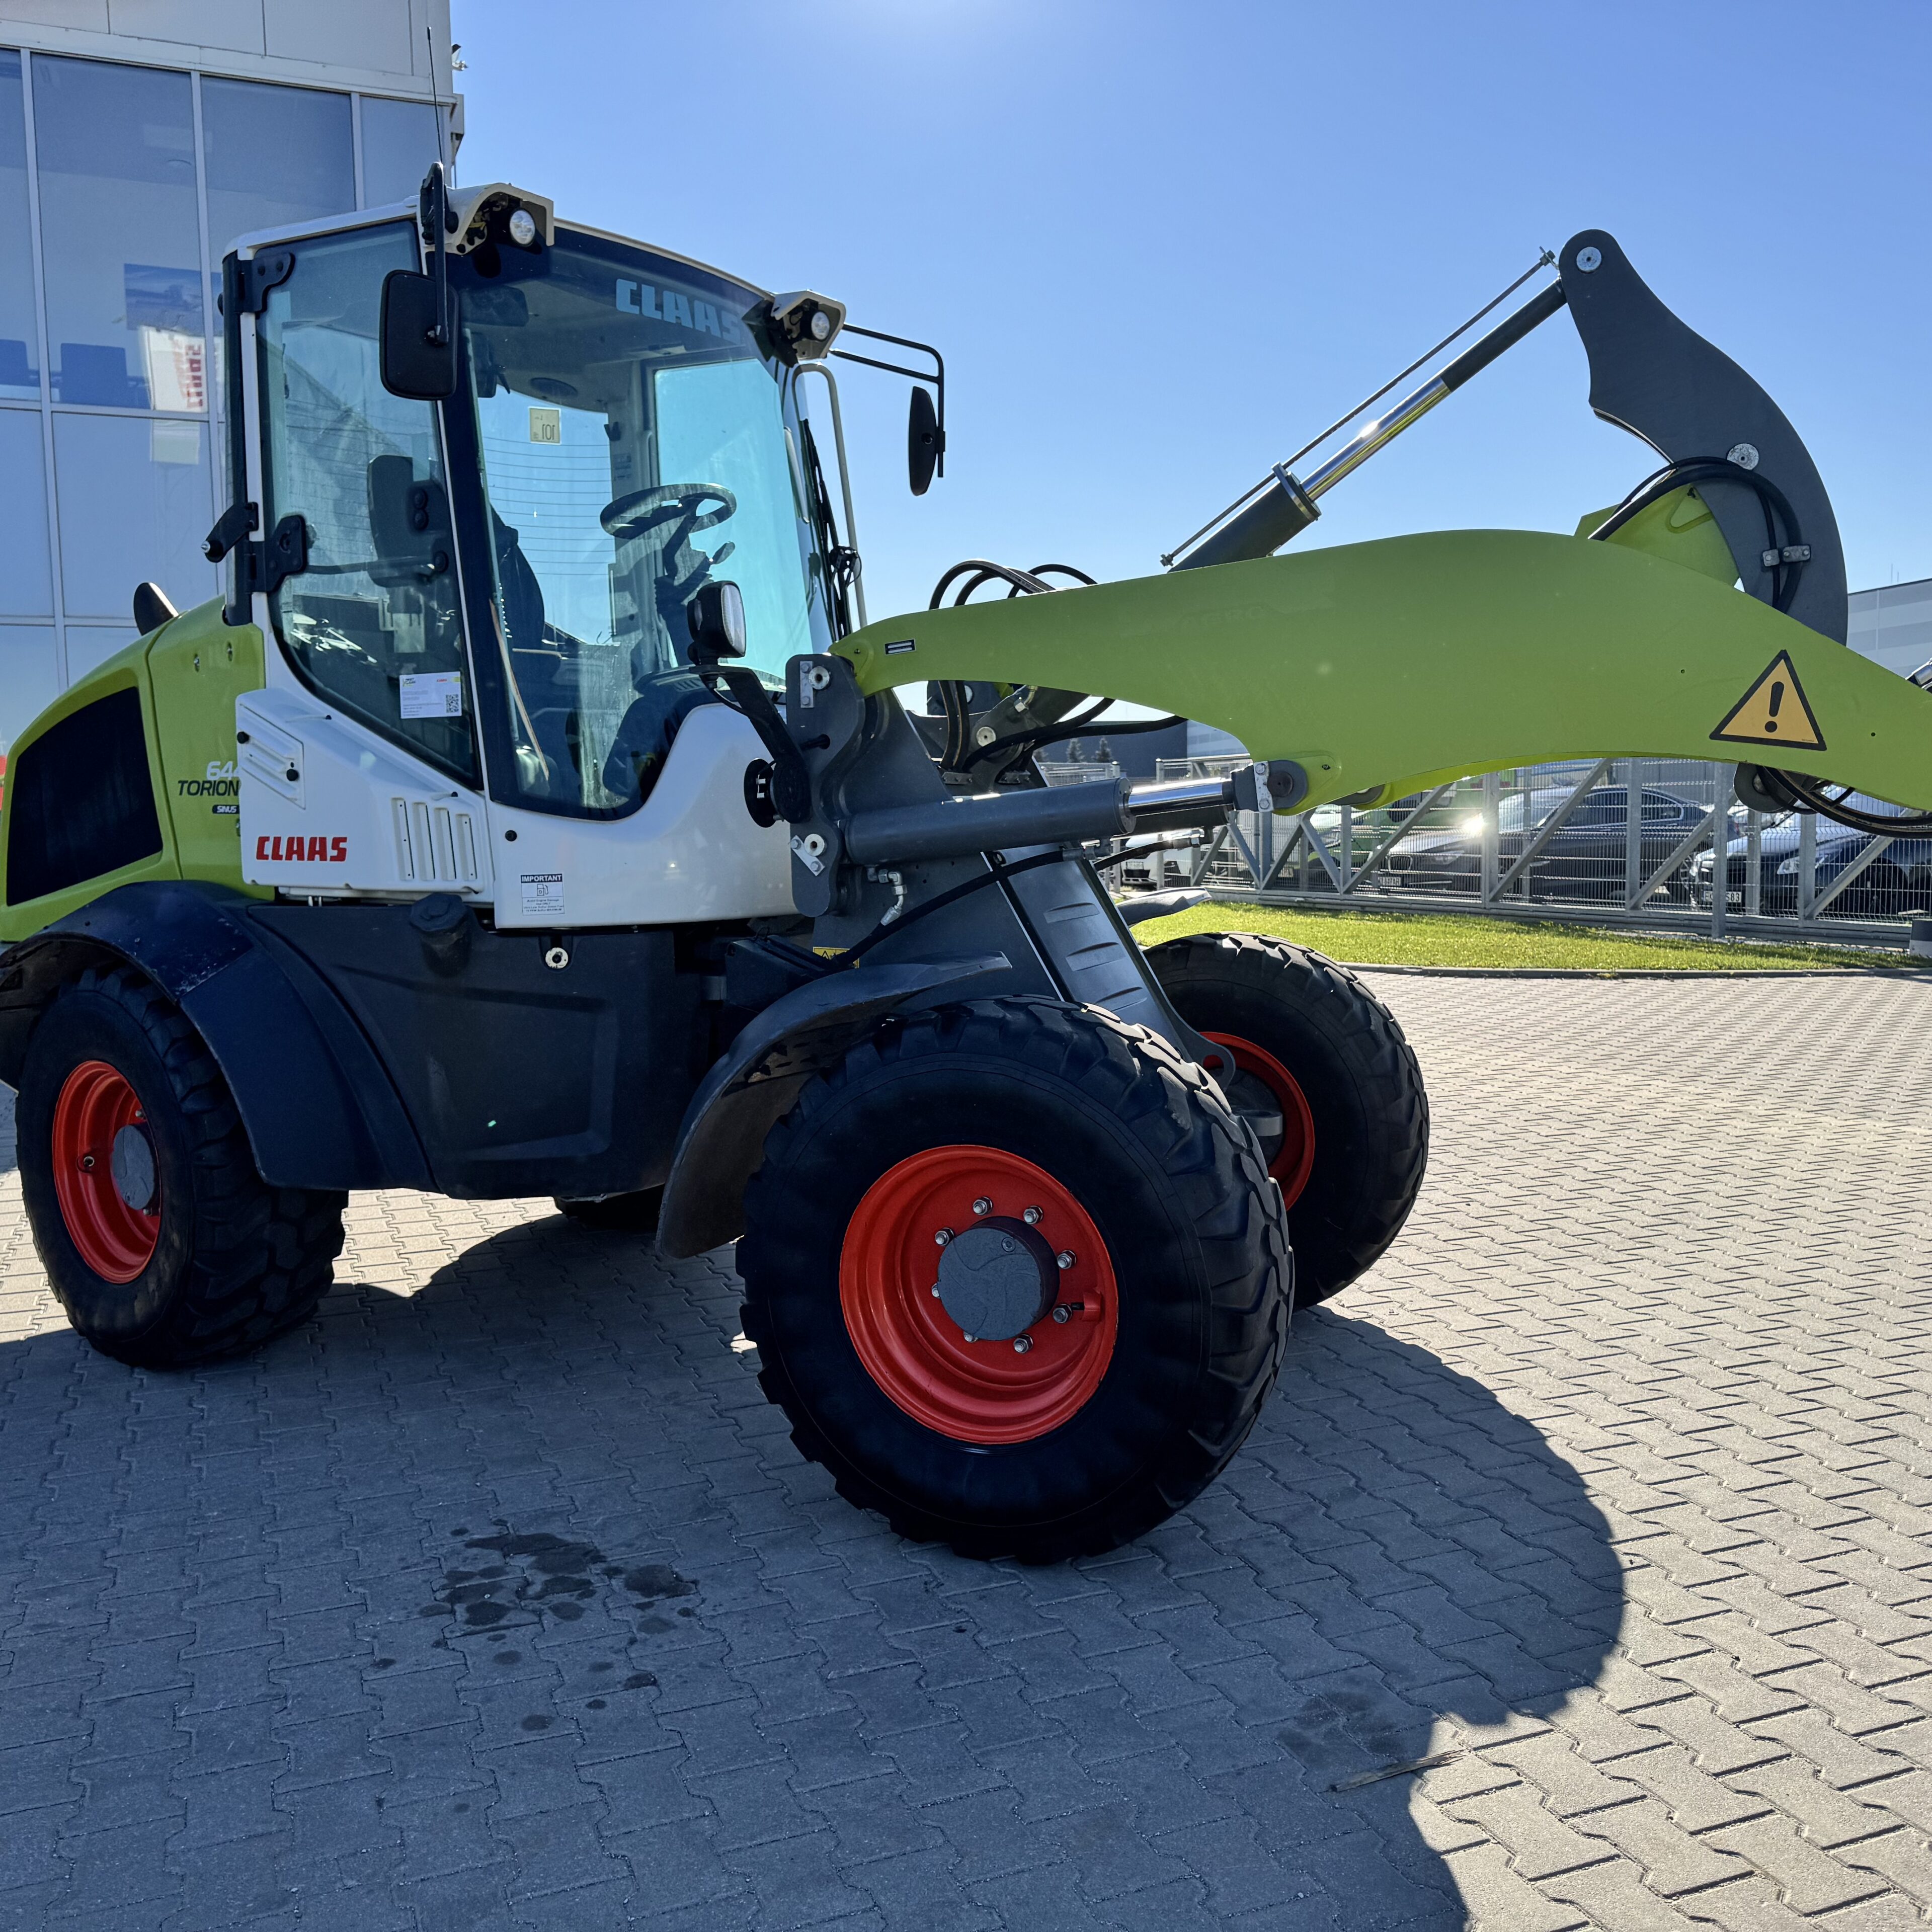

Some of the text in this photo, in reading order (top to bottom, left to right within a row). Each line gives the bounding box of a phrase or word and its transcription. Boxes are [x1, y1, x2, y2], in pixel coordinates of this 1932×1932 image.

[616, 279, 741, 345] CLAAS
[178, 780, 239, 796] TORION
[256, 836, 348, 862] CLAAS
